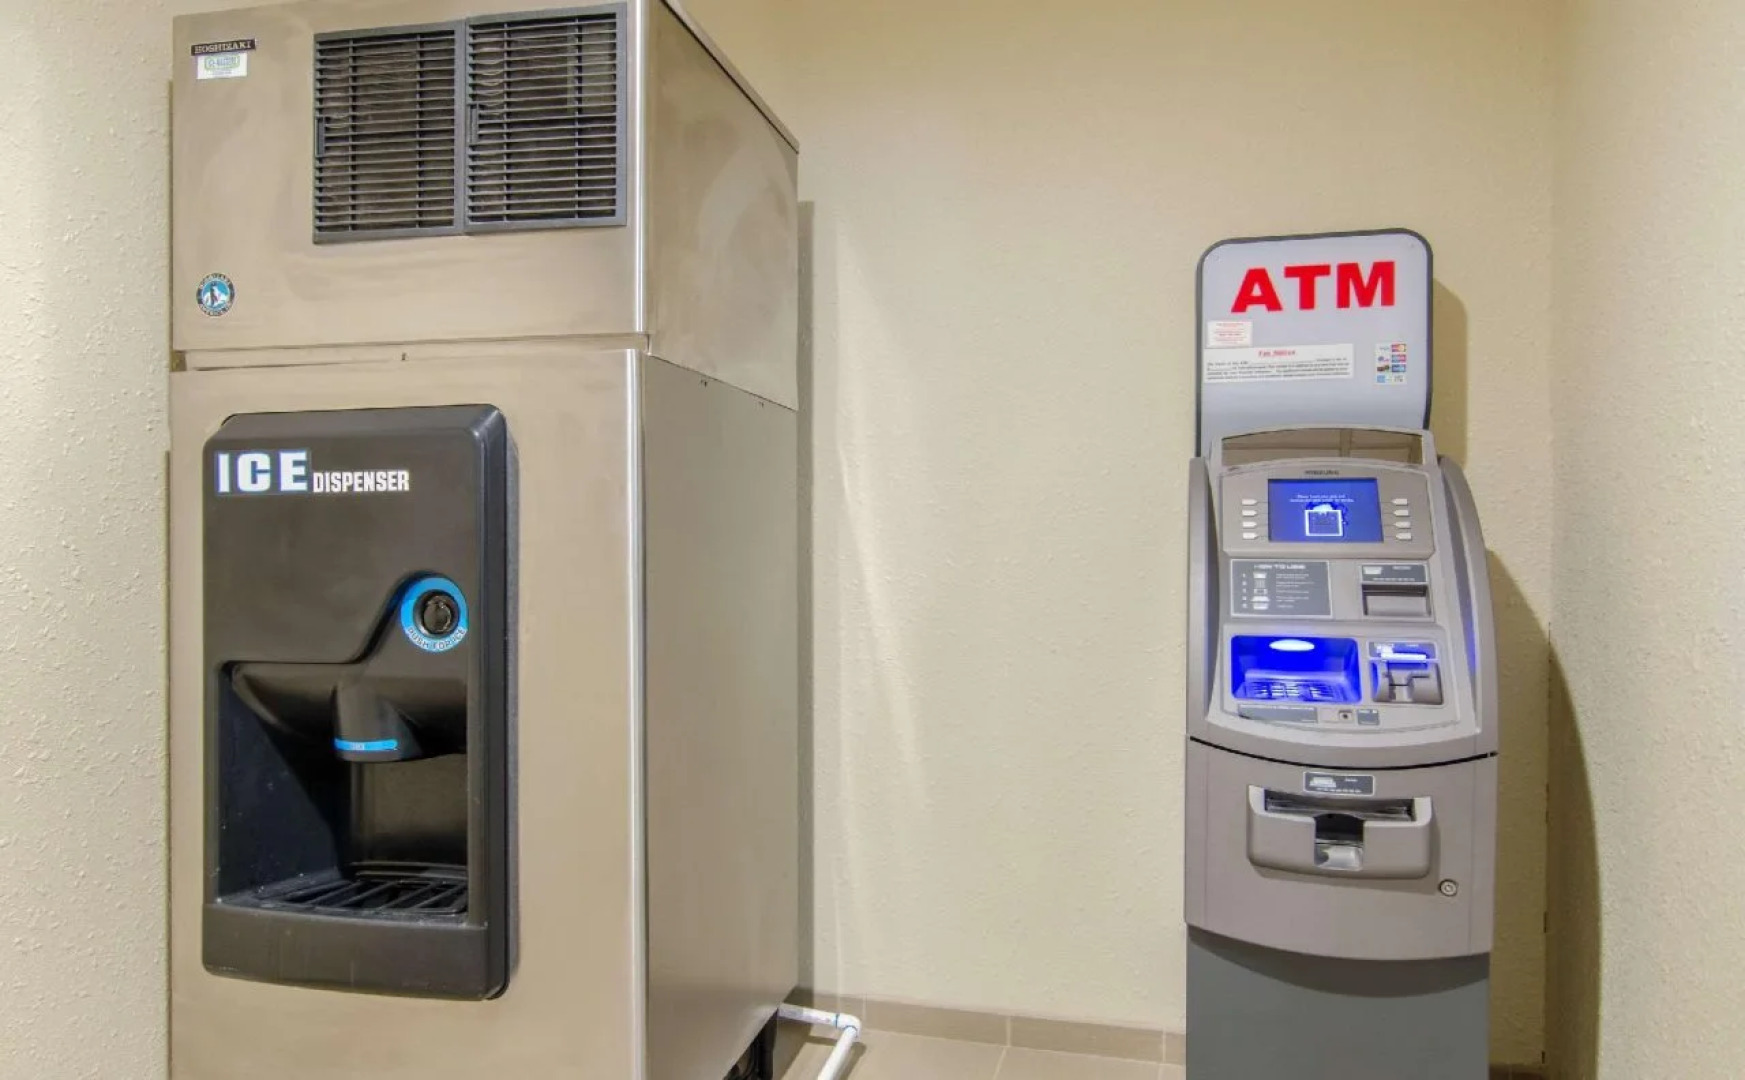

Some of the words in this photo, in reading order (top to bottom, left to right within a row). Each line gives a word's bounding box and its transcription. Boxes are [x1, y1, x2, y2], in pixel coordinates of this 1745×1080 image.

[194, 40, 252, 54] HOSHIZAKI
[1230, 260, 1395, 313] ATM
[217, 451, 308, 493] ICE
[312, 470, 410, 493] DISPENSER
[407, 627, 429, 649] PUSH
